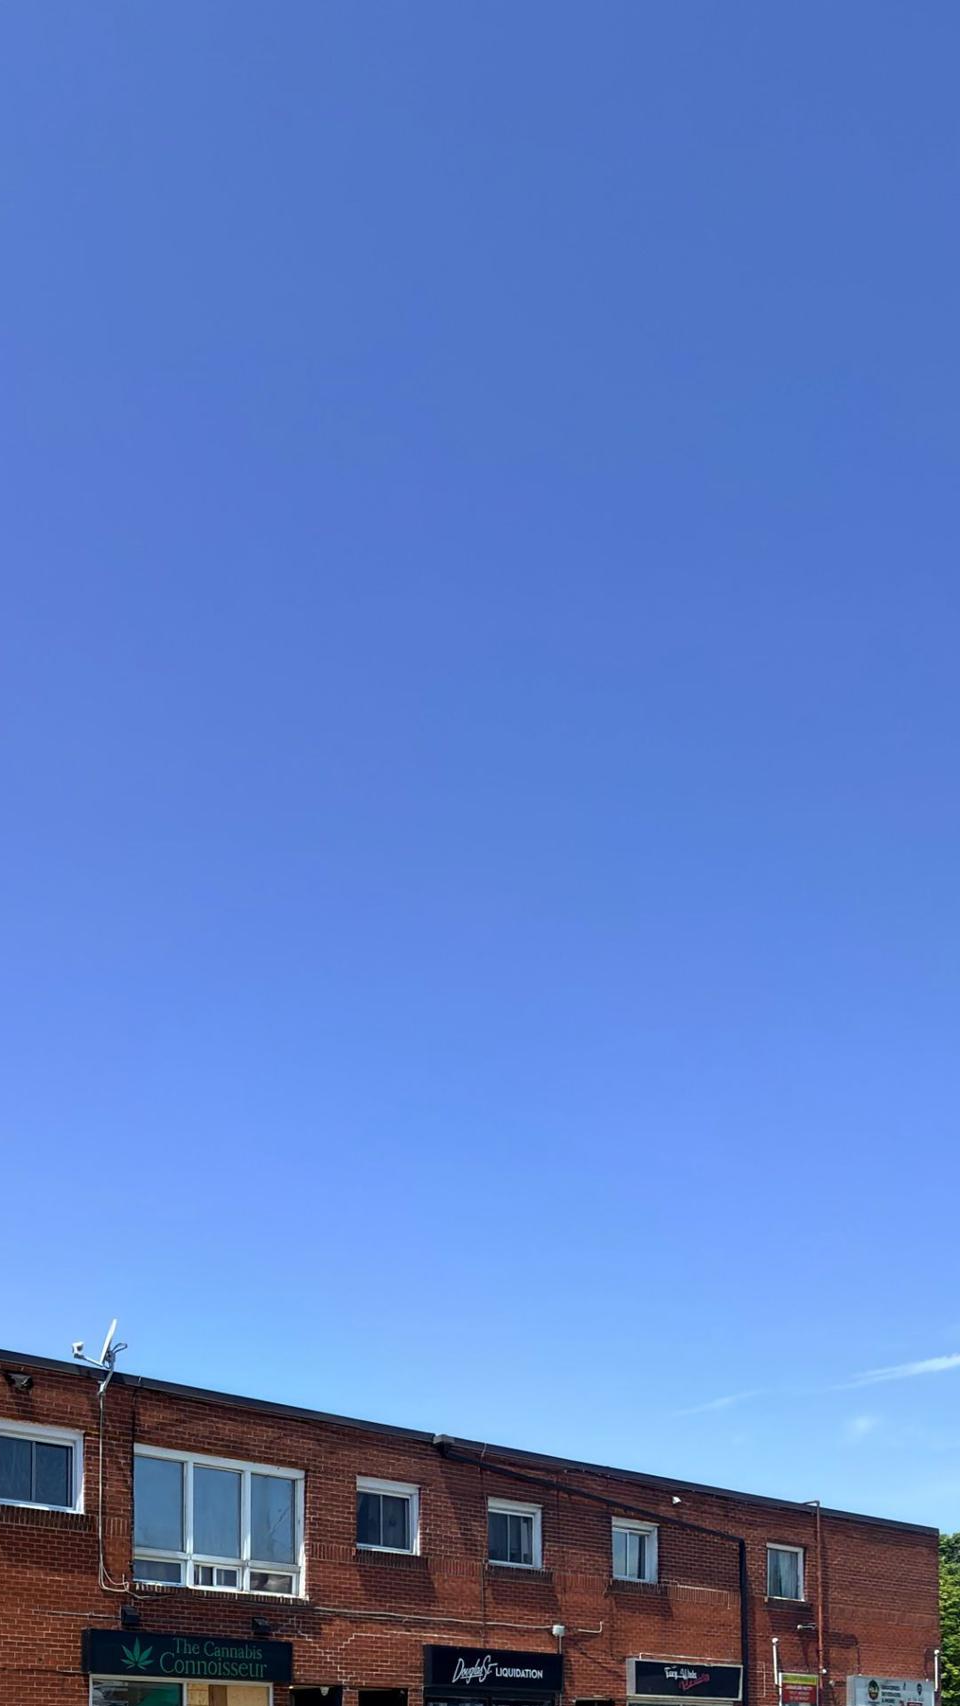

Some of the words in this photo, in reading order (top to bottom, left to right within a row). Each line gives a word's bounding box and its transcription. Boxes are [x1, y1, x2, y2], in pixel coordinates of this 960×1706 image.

[173, 1637, 200, 1655] The
[203, 1640, 263, 1660] Cannabis
[159, 1651, 268, 1678] Connoisseur
[495, 1667, 544, 1679] LIQUIDATION
